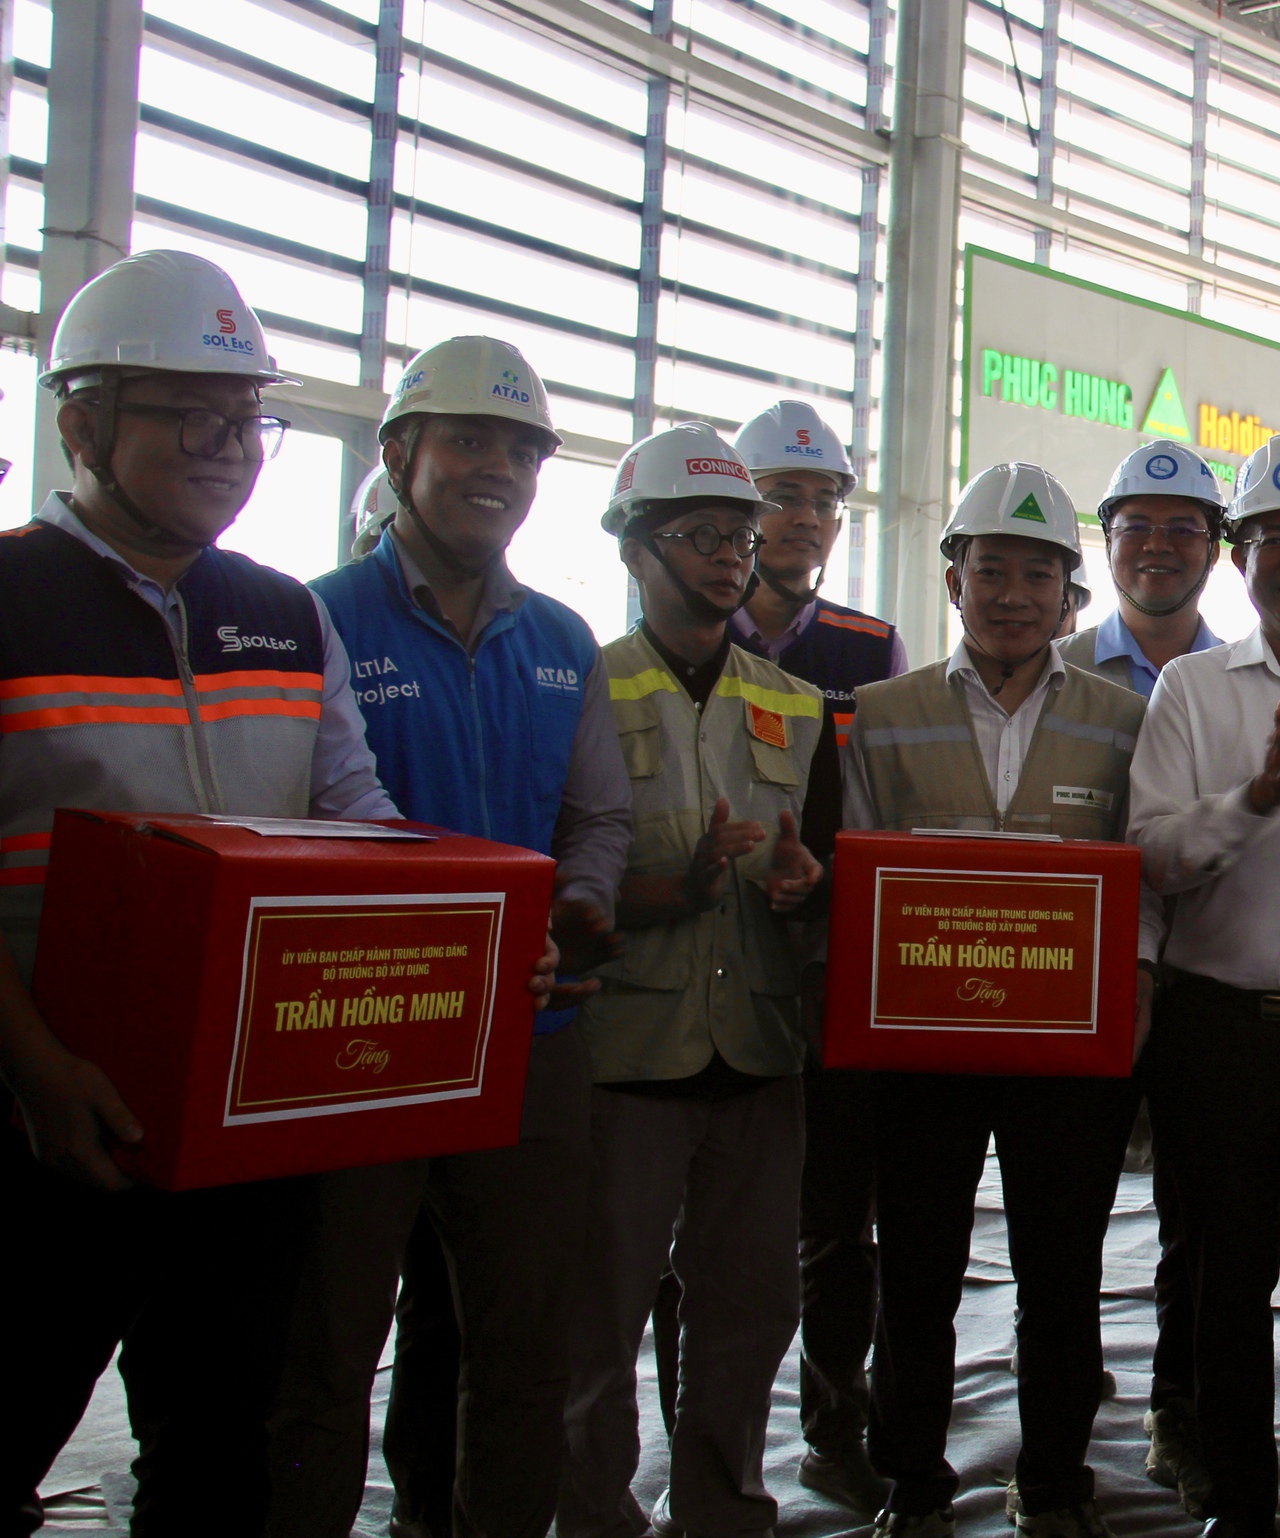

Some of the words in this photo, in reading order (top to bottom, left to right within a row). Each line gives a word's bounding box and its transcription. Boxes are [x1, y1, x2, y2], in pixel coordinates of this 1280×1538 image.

[203, 334, 228, 347] SOL
[231, 337, 253, 351] E&C
[492, 384, 529, 403] ATAD
[983, 348, 1058, 411] PHUC
[1064, 369, 1134, 430] HUNG
[1199, 403, 1280, 457] Holdin
[785, 445, 803, 454] SOL
[689, 460, 750, 480] CONINCO
[355, 656, 398, 678] LTIA
[536, 666, 578, 685] ATAD
[356, 680, 420, 705] roject
[914, 904, 932, 916] VIÊN
[933, 907, 951, 917] BAN
[976, 906, 999, 918] HÀNH
[1000, 909, 1027, 920] TRUNG
[938, 918, 950, 932] BỘ
[985, 920, 997, 933] BỘ
[999, 920, 1013, 932] XÂY
[297, 947, 317, 964] VIÊN
[319, 951, 338, 963] BAN
[366, 945, 391, 961] HÀNH
[393, 947, 420, 960] TRUNG
[898, 935, 952, 967] TRẦN
[957, 937, 1015, 969] HỒNG
[1021, 947, 1074, 970] MINH
[322, 965, 336, 983] BỘ
[375, 963, 388, 980] BỘ
[390, 962, 405, 977] XÂY
[956, 977, 1008, 1008] Tặng
[275, 989, 335, 1032] TRẦN
[341, 986, 404, 1027] HỒNG
[409, 991, 465, 1022] MINH
[335, 1039, 391, 1074] Tặng
